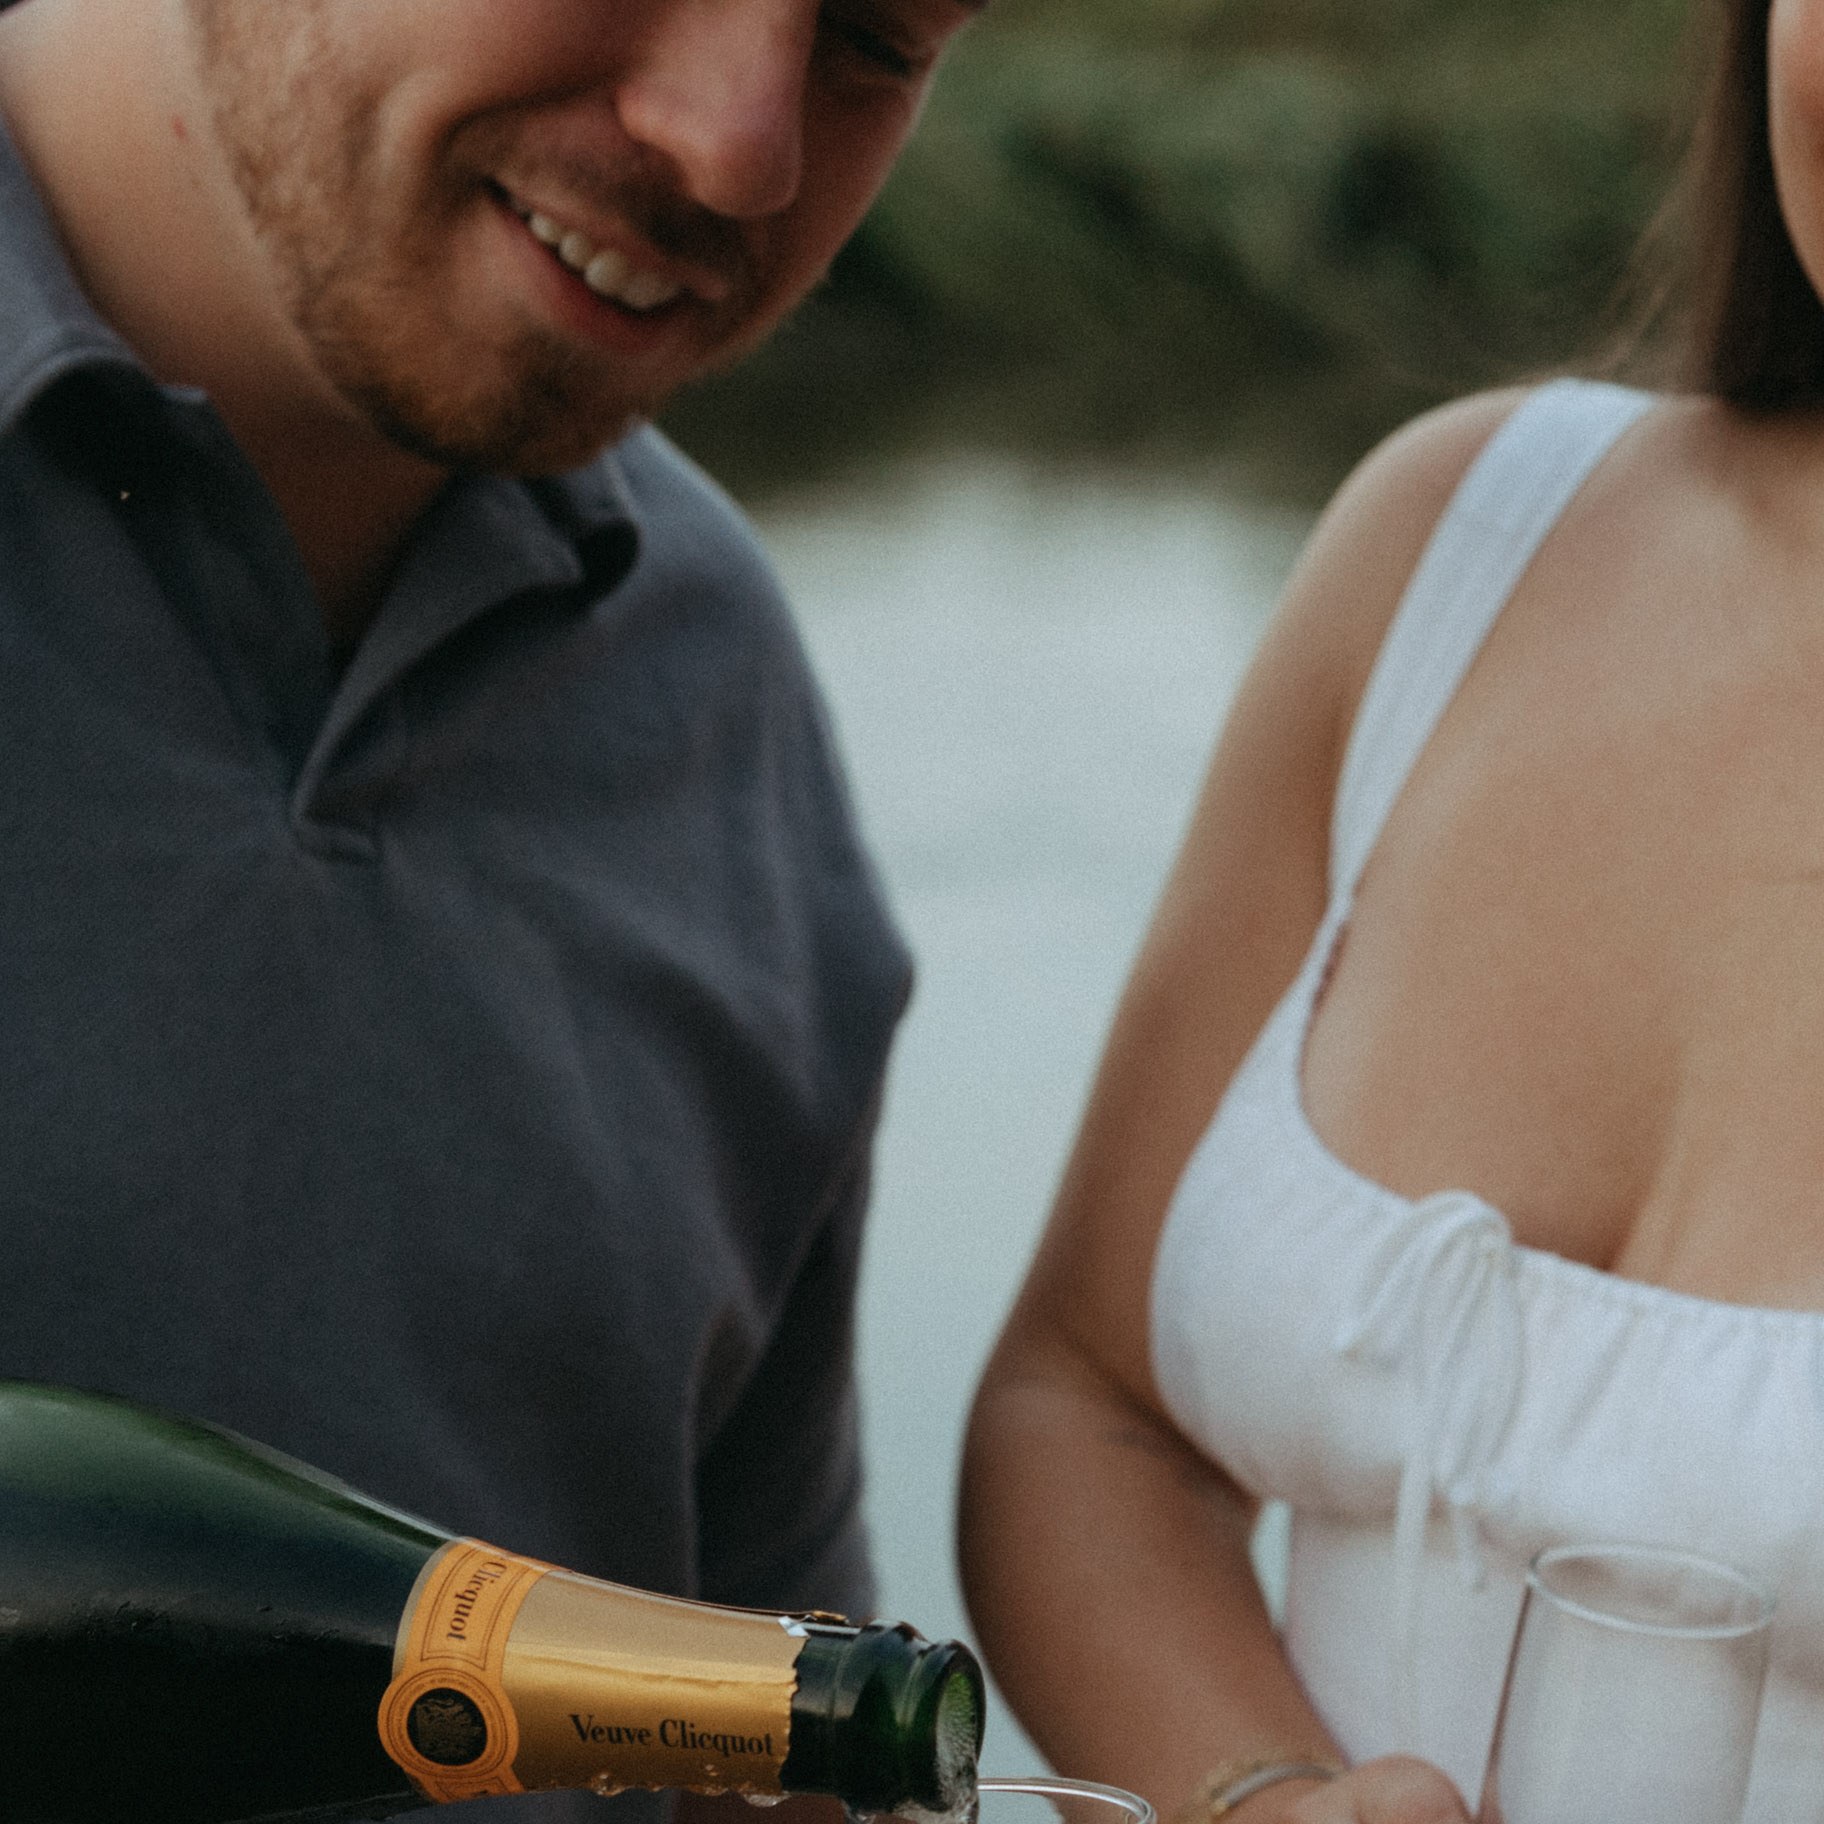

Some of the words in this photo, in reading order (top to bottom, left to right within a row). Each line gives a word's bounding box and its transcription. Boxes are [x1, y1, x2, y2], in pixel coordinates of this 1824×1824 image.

[447, 1561, 507, 1641] Clicquot
[568, 1714, 652, 1746] Veuve
[659, 1718, 774, 1758] Clicquot
